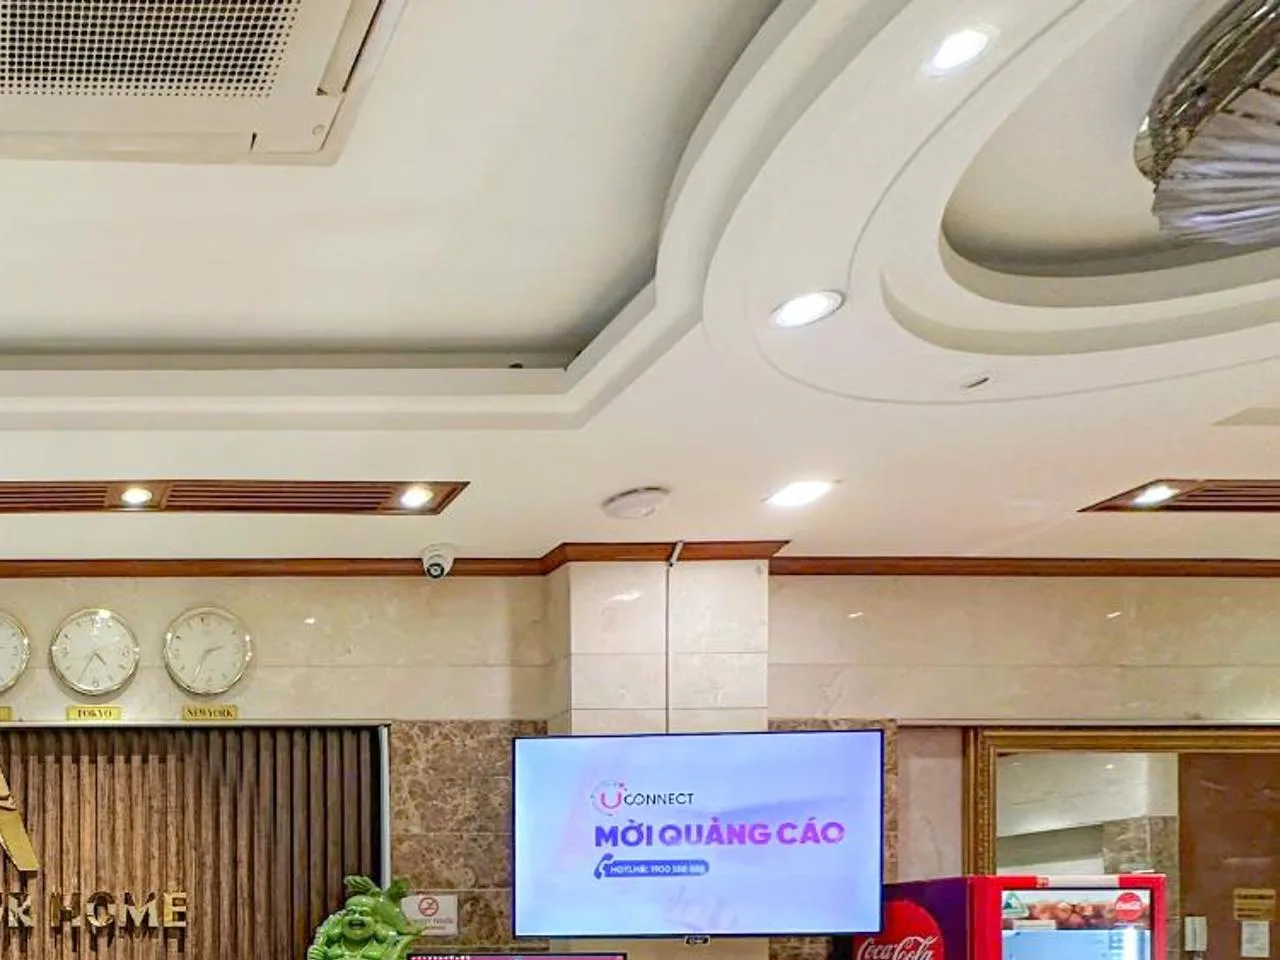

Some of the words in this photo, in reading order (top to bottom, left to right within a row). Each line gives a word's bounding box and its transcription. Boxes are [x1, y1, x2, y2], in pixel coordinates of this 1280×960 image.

[77, 709, 113, 718] TOKYO
[595, 819, 653, 848] MỜI
[659, 816, 771, 847] QUẢNG
[776, 816, 846, 846] CÁO
[50, 891, 188, 929] HOME
